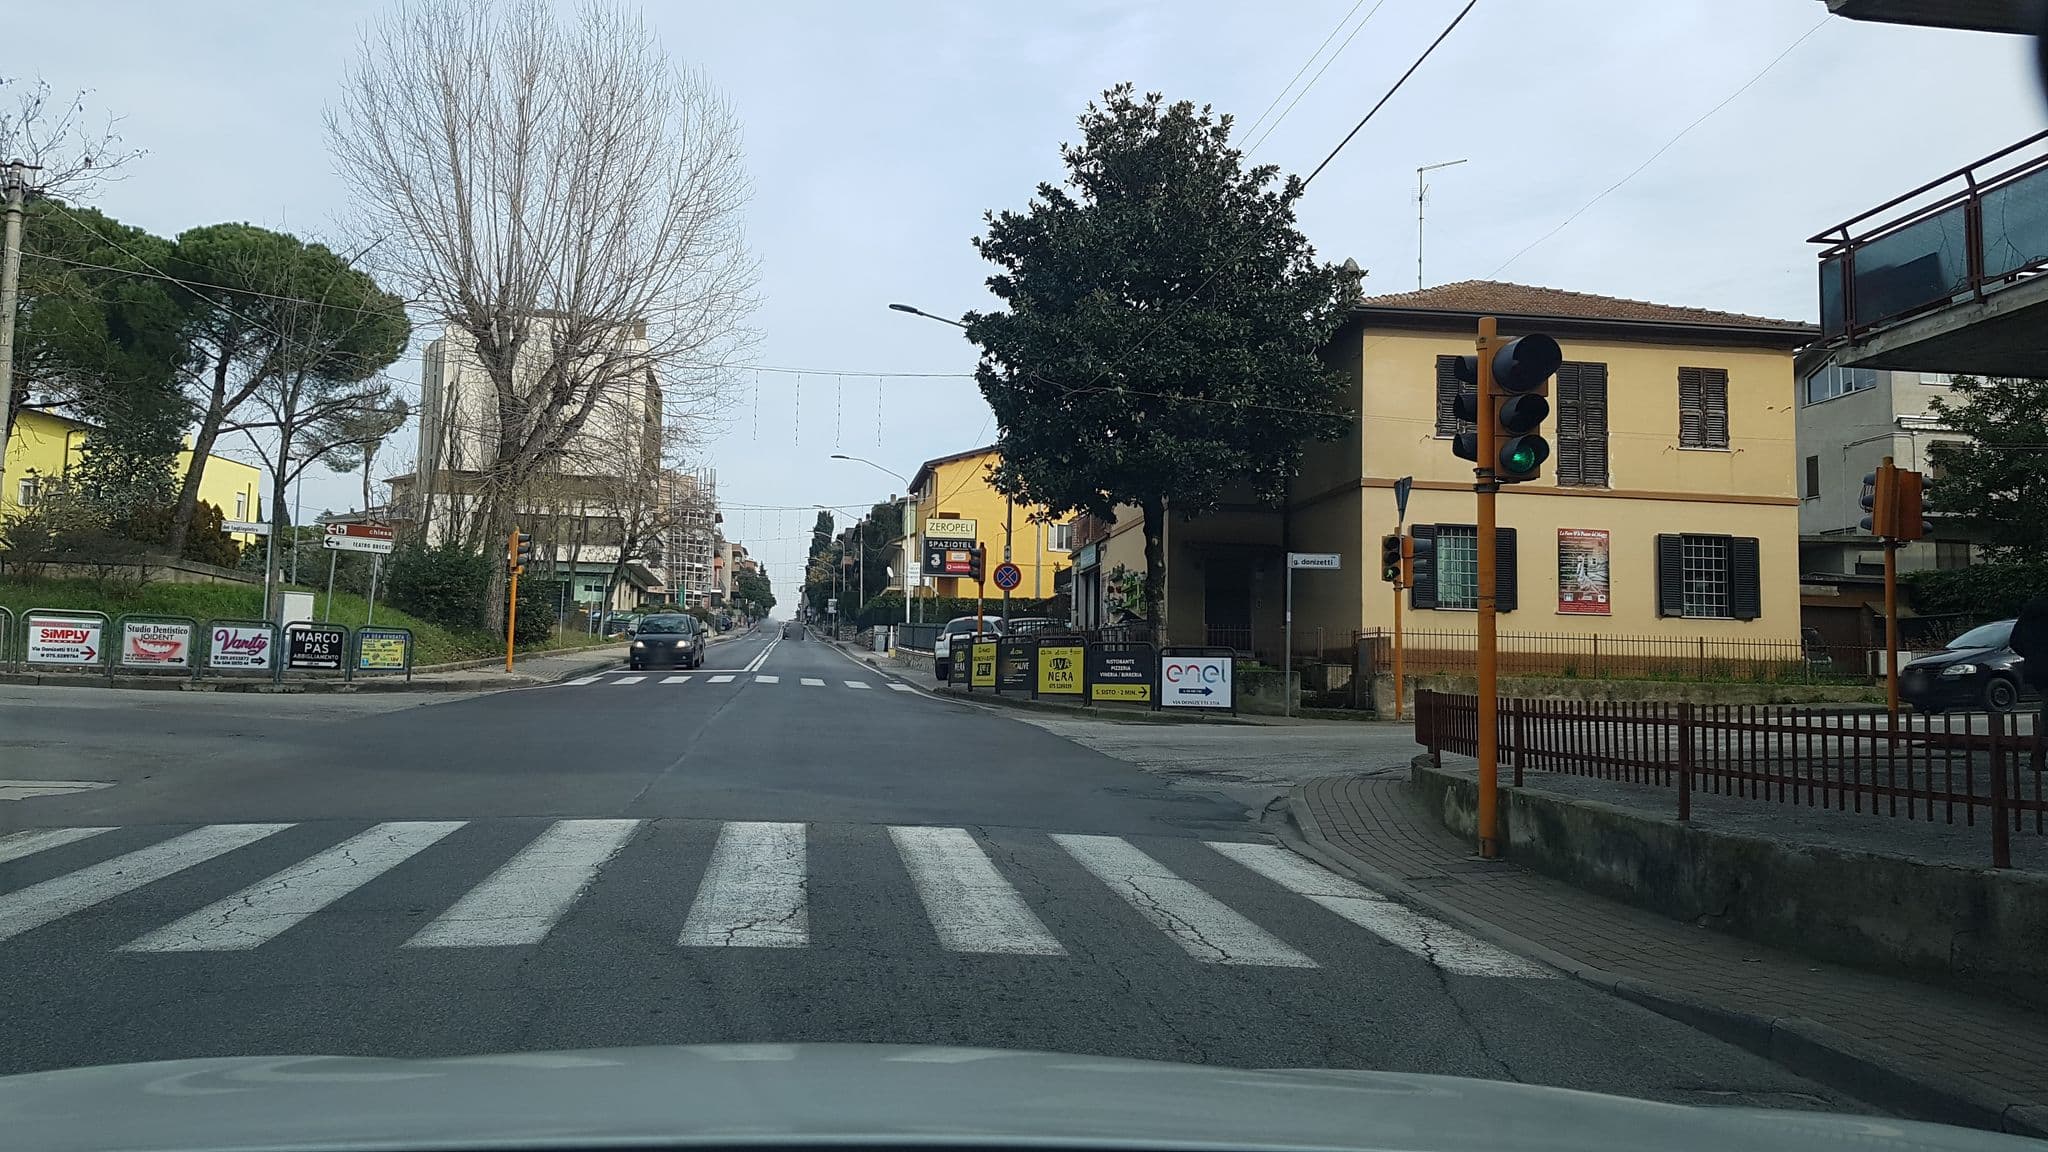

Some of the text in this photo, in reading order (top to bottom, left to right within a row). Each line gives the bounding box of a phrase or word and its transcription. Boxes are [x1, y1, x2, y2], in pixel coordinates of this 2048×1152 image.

[929, 522, 973, 532] ZEROPELI
[928, 540, 972, 548] SPAZIOTEL
[1301, 558, 1333, 566] donizetti
[127, 624, 188, 635] Studio Dentistico
[215, 629, 269, 656] Vanity
[296, 631, 339, 644] MARCO
[304, 643, 329, 654] PAS
[293, 653, 339, 661] ABBIGLIAMENTO
[1051, 657, 1071, 670] UVA
[1047, 671, 1074, 682] NERA
[1166, 660, 1226, 684] enel
